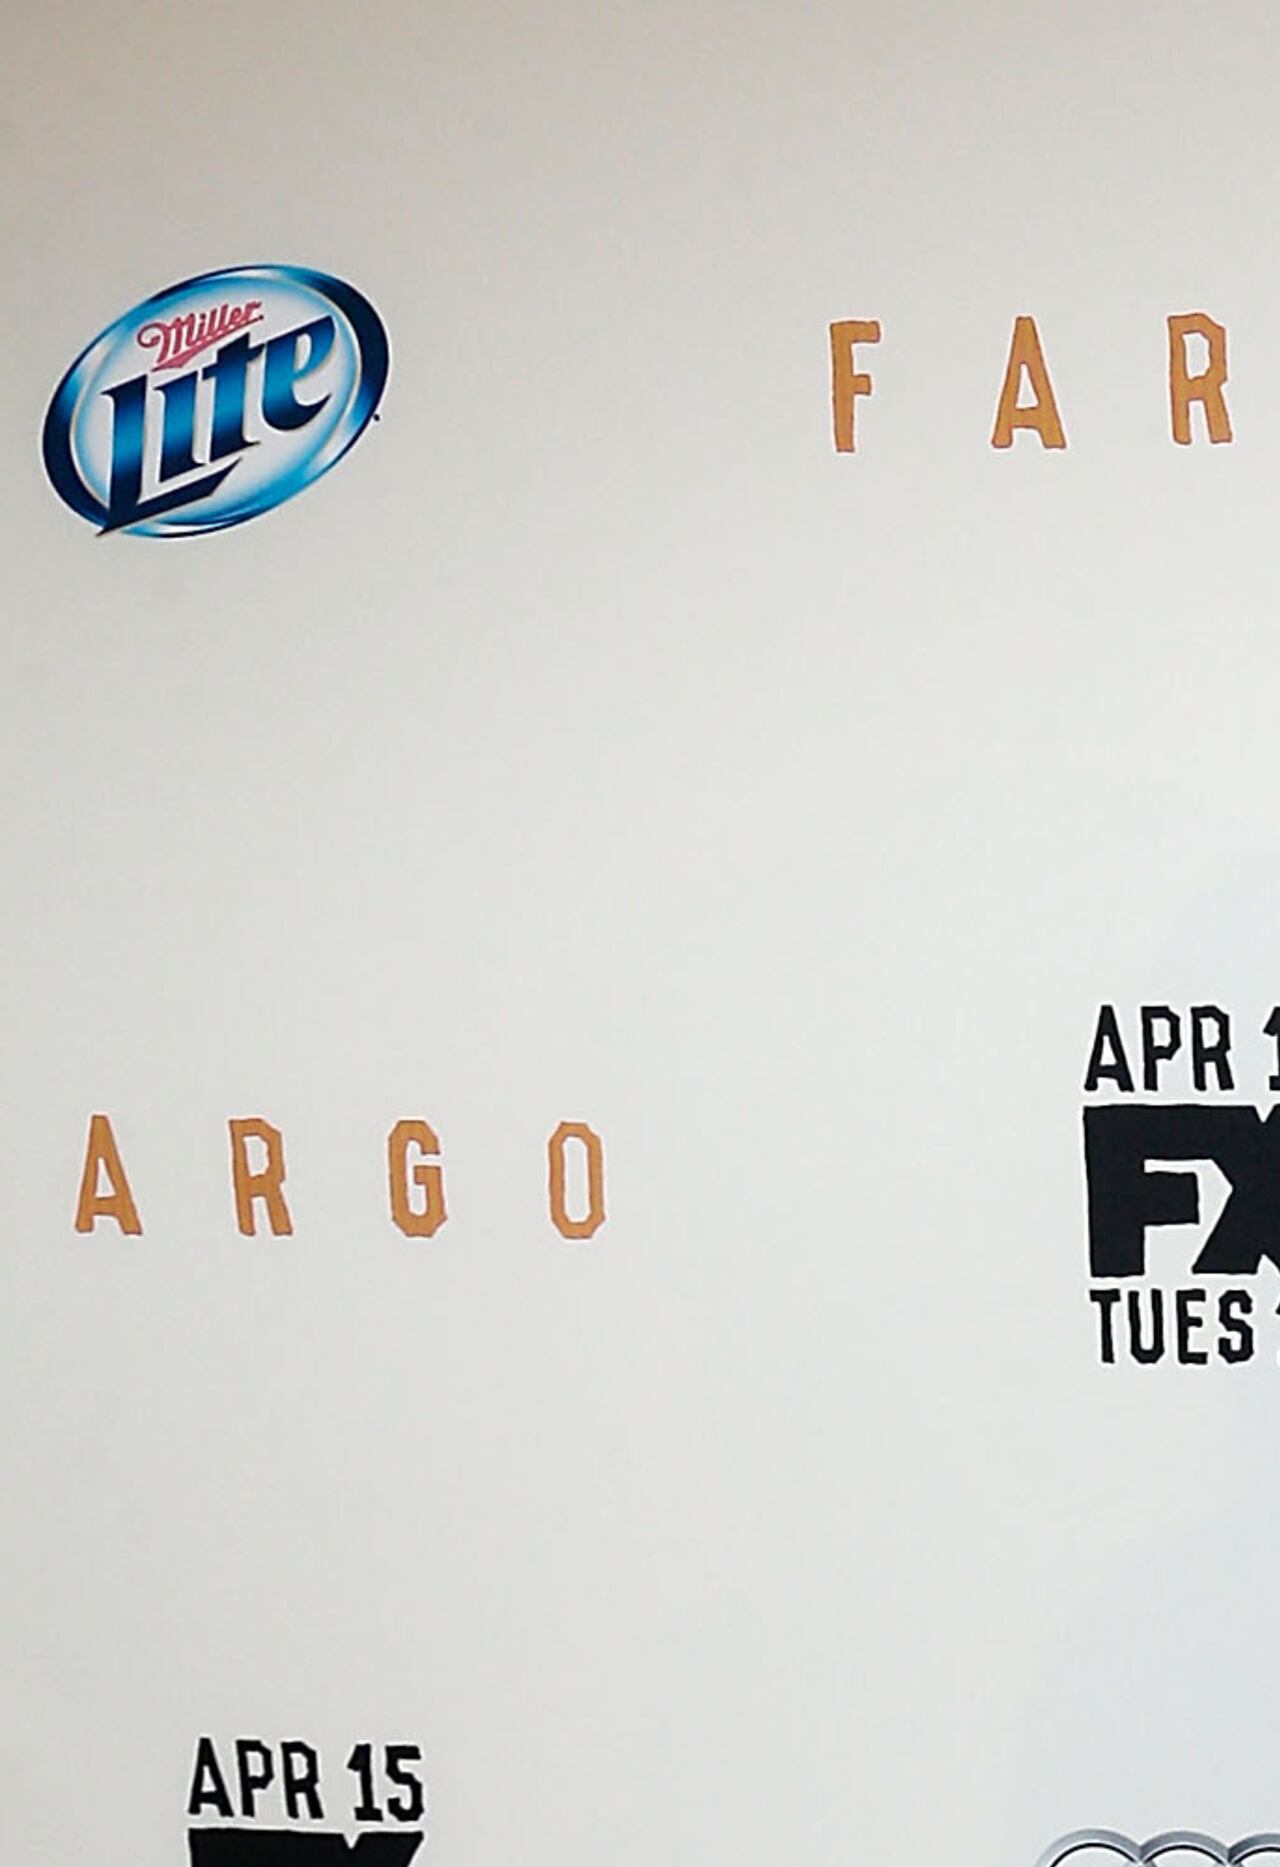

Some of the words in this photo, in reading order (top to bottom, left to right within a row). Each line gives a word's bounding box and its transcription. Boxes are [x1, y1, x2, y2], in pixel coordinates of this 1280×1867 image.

[137, 300, 264, 372] Miller
[95, 315, 336, 537] Lite
[1084, 1004, 1235, 1093] APR
[74, 1114, 605, 1239] ARGO
[1089, 1288, 1254, 1365] TUES
[187, 1737, 324, 1820] APR
[347, 1743, 425, 1823] 15
